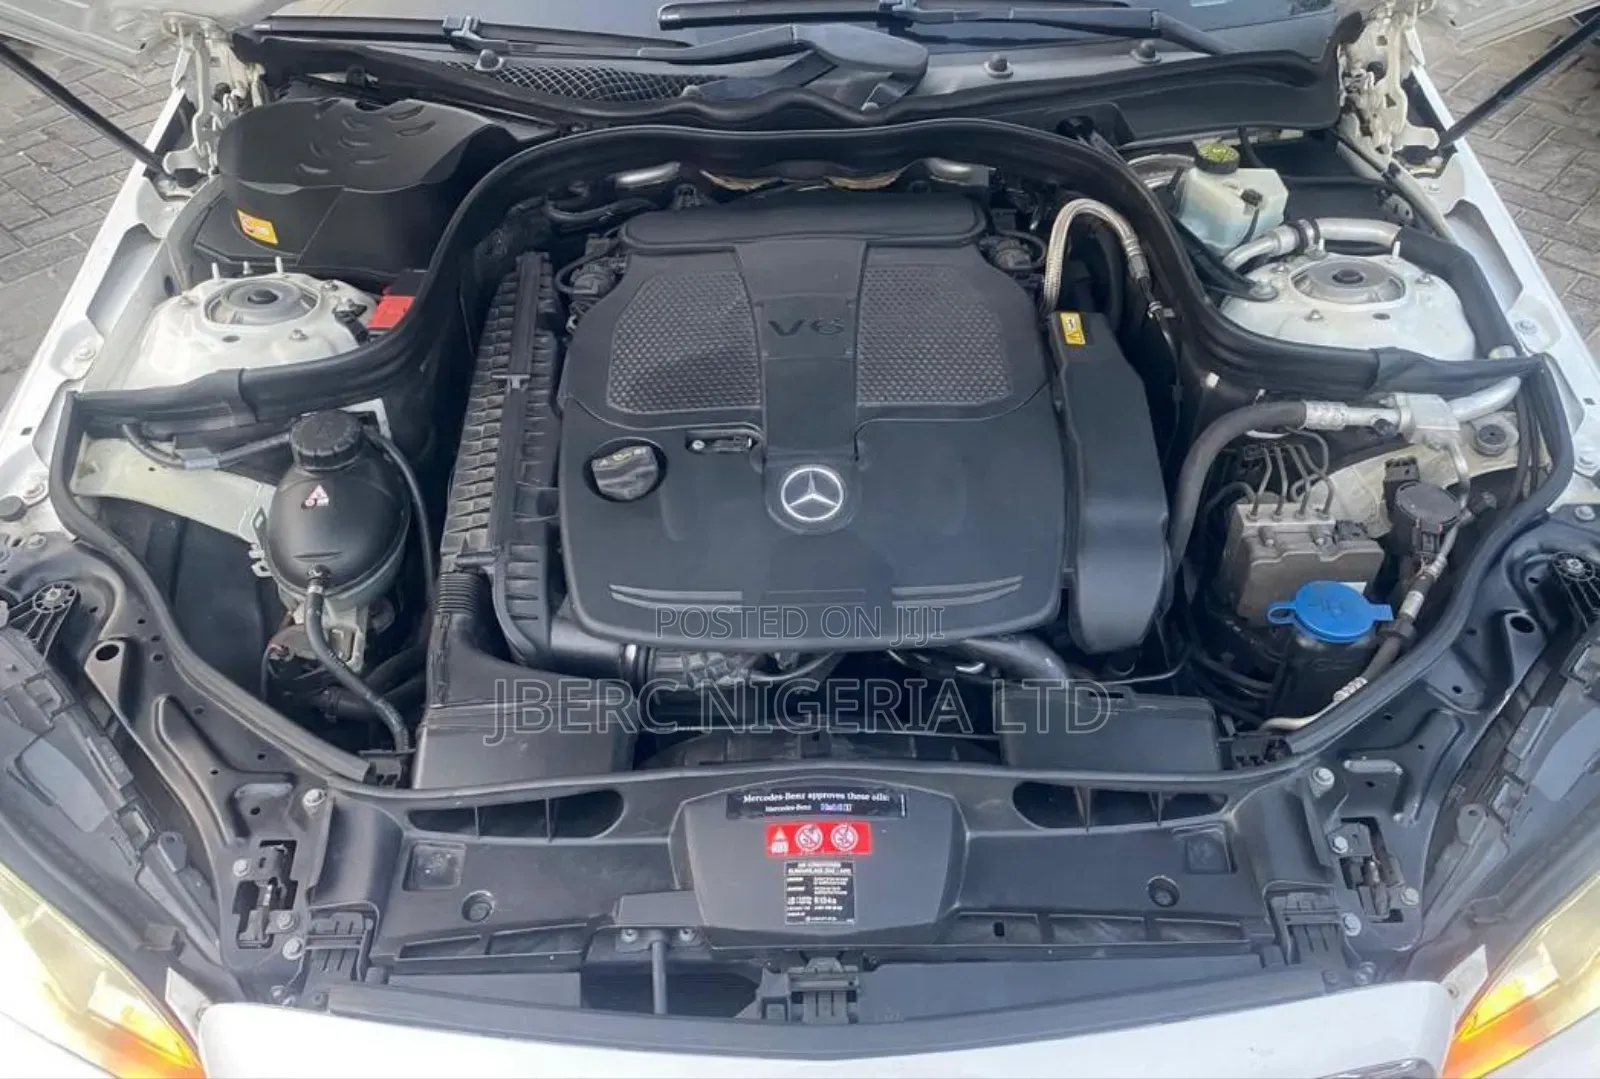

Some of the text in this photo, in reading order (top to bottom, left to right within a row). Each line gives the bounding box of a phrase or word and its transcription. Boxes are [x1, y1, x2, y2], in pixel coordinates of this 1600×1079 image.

[767, 318, 845, 337] V6
[743, 792, 806, 803] Mercedes-Benz
[807, 792, 846, 801] approves
[847, 791, 870, 801] these
[765, 804, 812, 812] Mercedes-Benz
